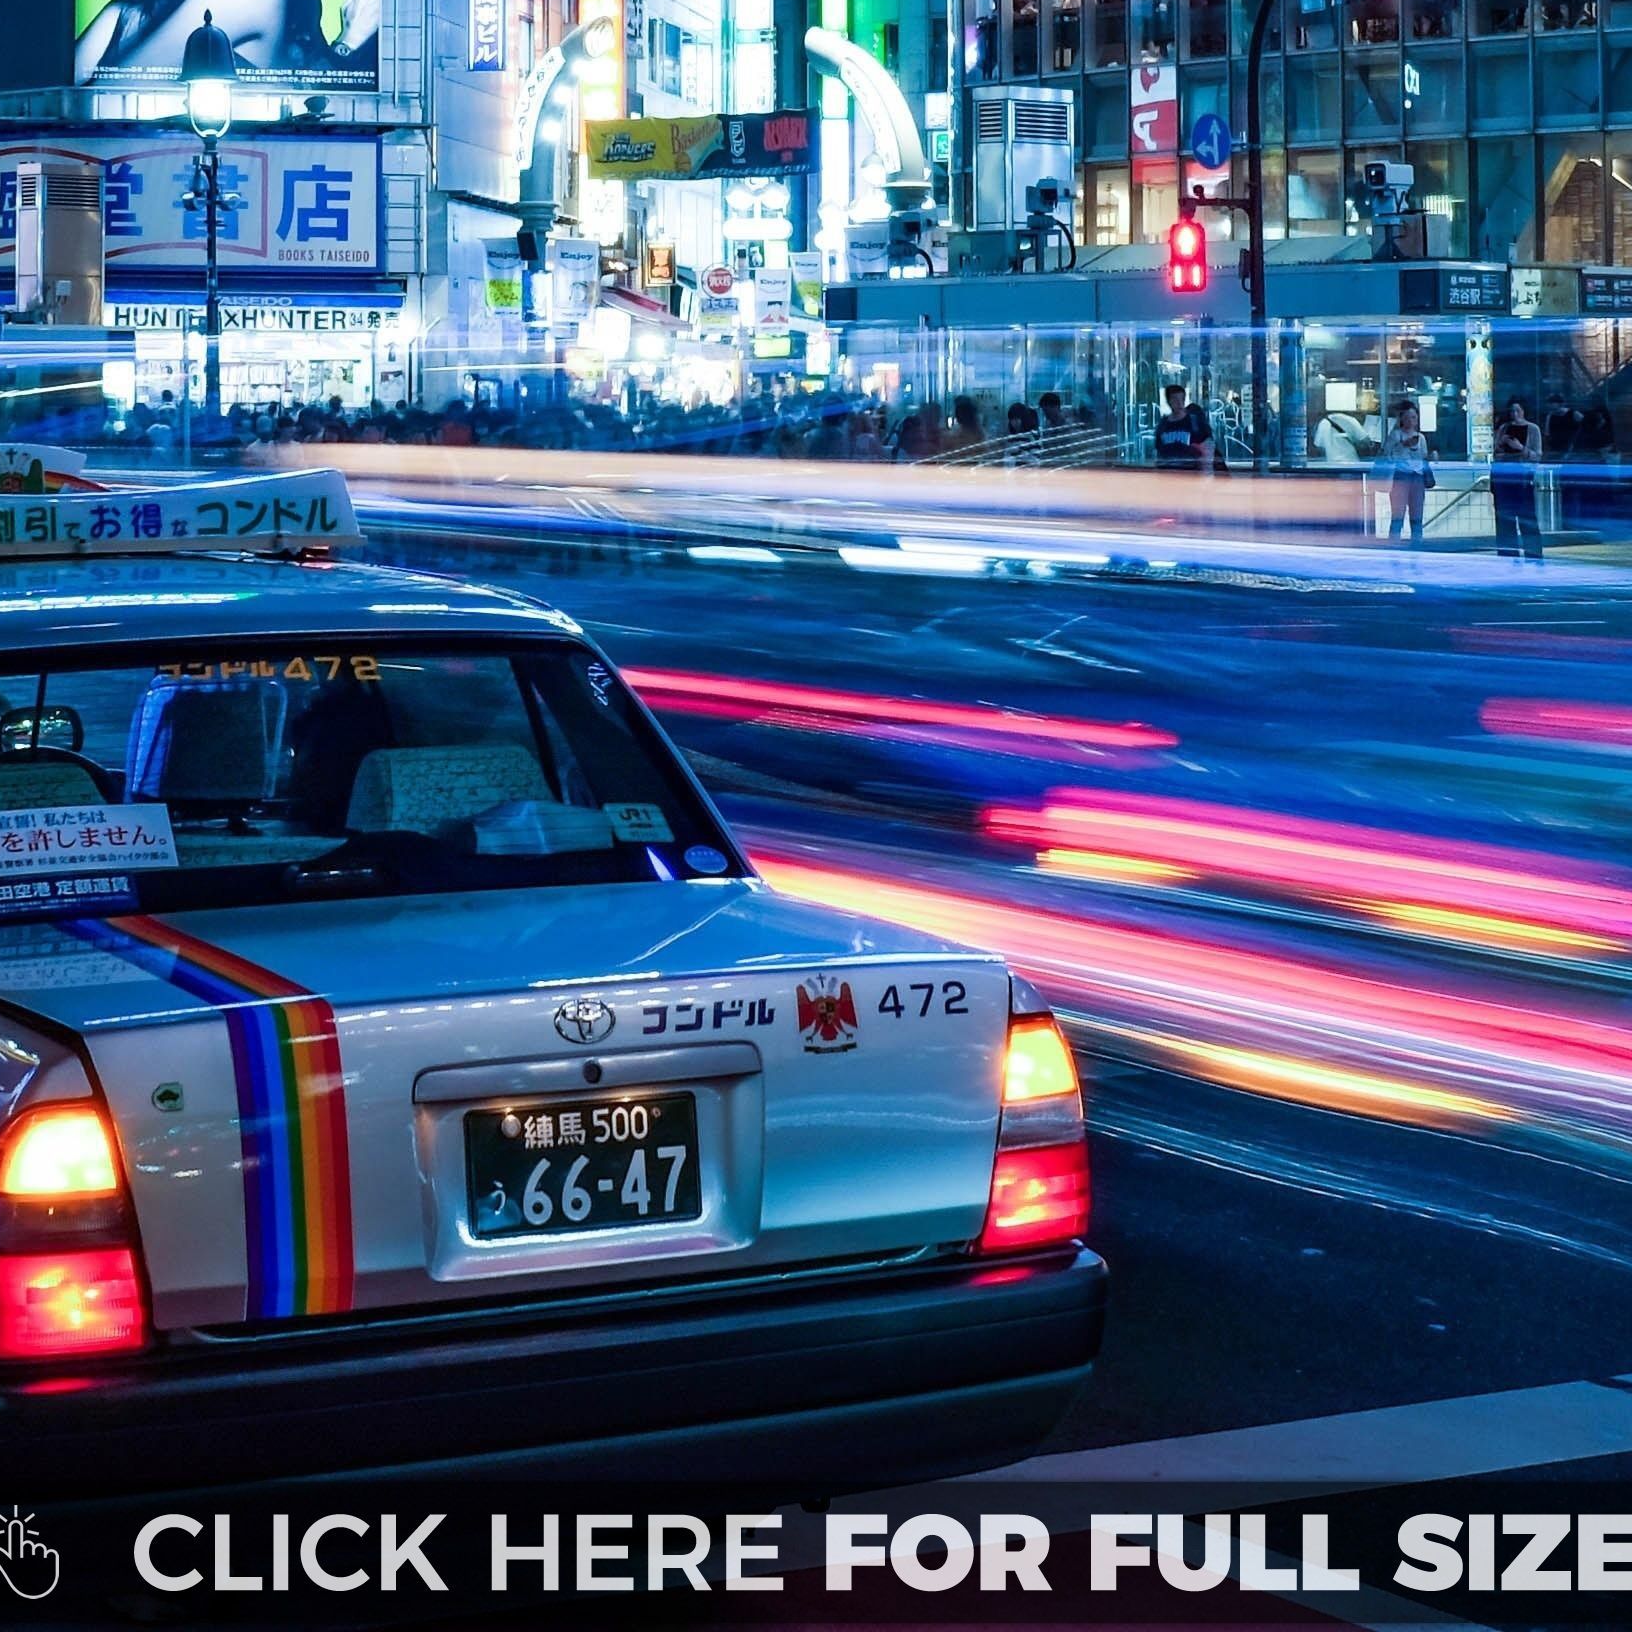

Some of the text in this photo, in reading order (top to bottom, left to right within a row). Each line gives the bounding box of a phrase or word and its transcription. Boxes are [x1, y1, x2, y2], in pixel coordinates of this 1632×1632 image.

[278, 249, 370, 263] BOOKS TAISEIDO
[560, 251, 594, 263] Enjoy
[850, 239, 886, 253] Enjoy
[43, 810, 107, 826] 私たちは
[878, 980, 969, 1019] 472
[643, 998, 775, 1036] コンドル
[522, 1105, 649, 1150] 練馬 500
[522, 1145, 687, 1227] 66-47
